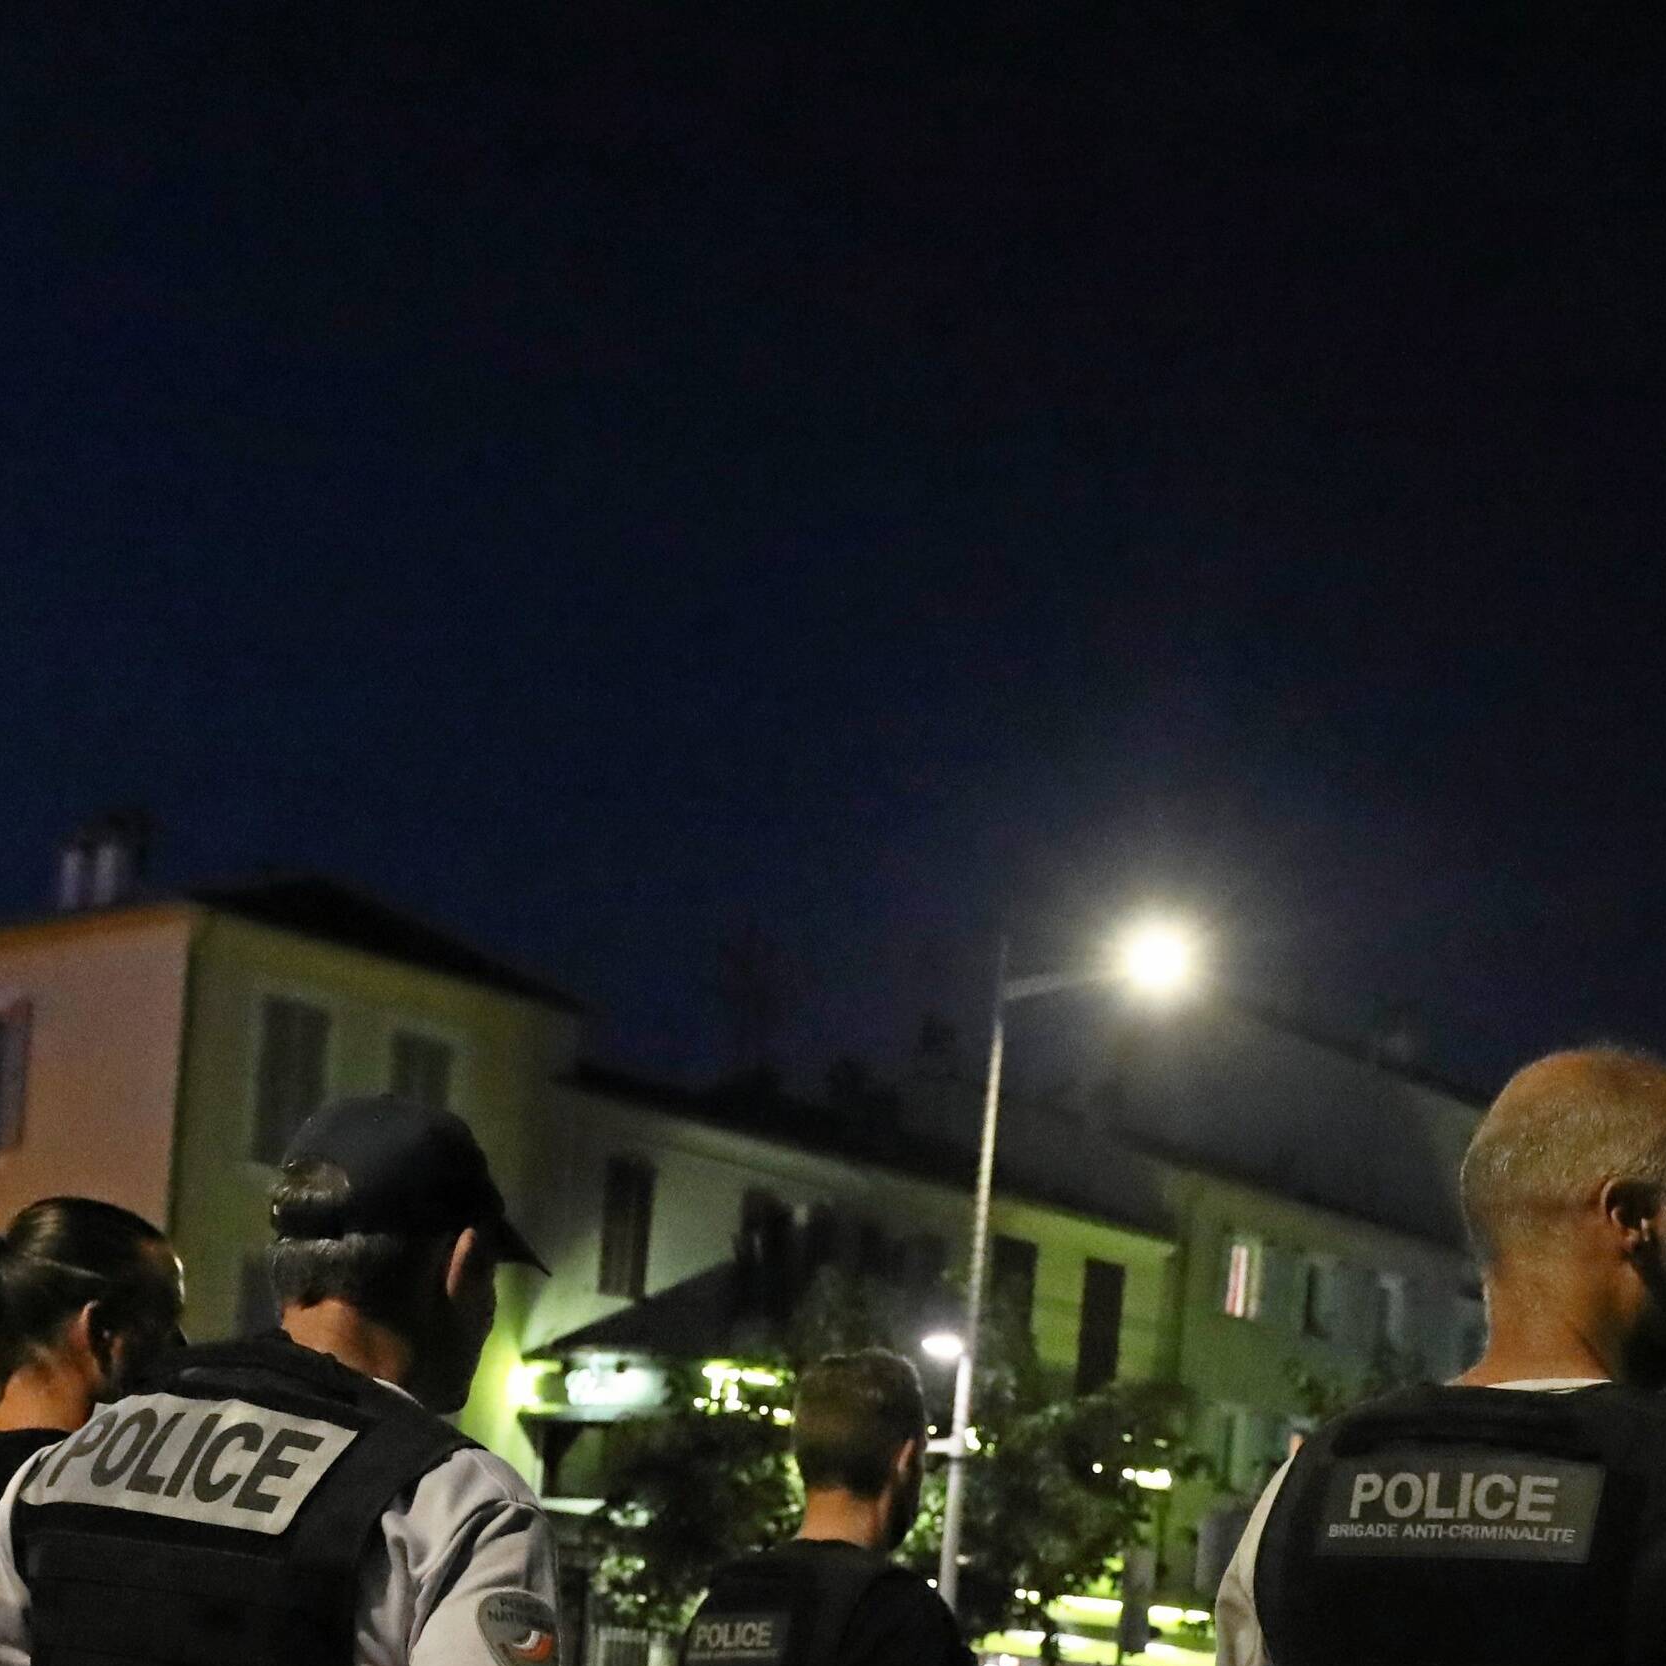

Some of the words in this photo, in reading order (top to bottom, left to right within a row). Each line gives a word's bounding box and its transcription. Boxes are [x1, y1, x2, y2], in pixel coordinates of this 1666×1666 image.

[46, 1407, 326, 1515] POLICE
[1349, 1471, 1560, 1522] POLICE
[1329, 1523, 1398, 1538] BRIGADE
[1402, 1523, 1577, 1544] ANTI-CRIMINALITE
[695, 1621, 773, 1650] POLICE
